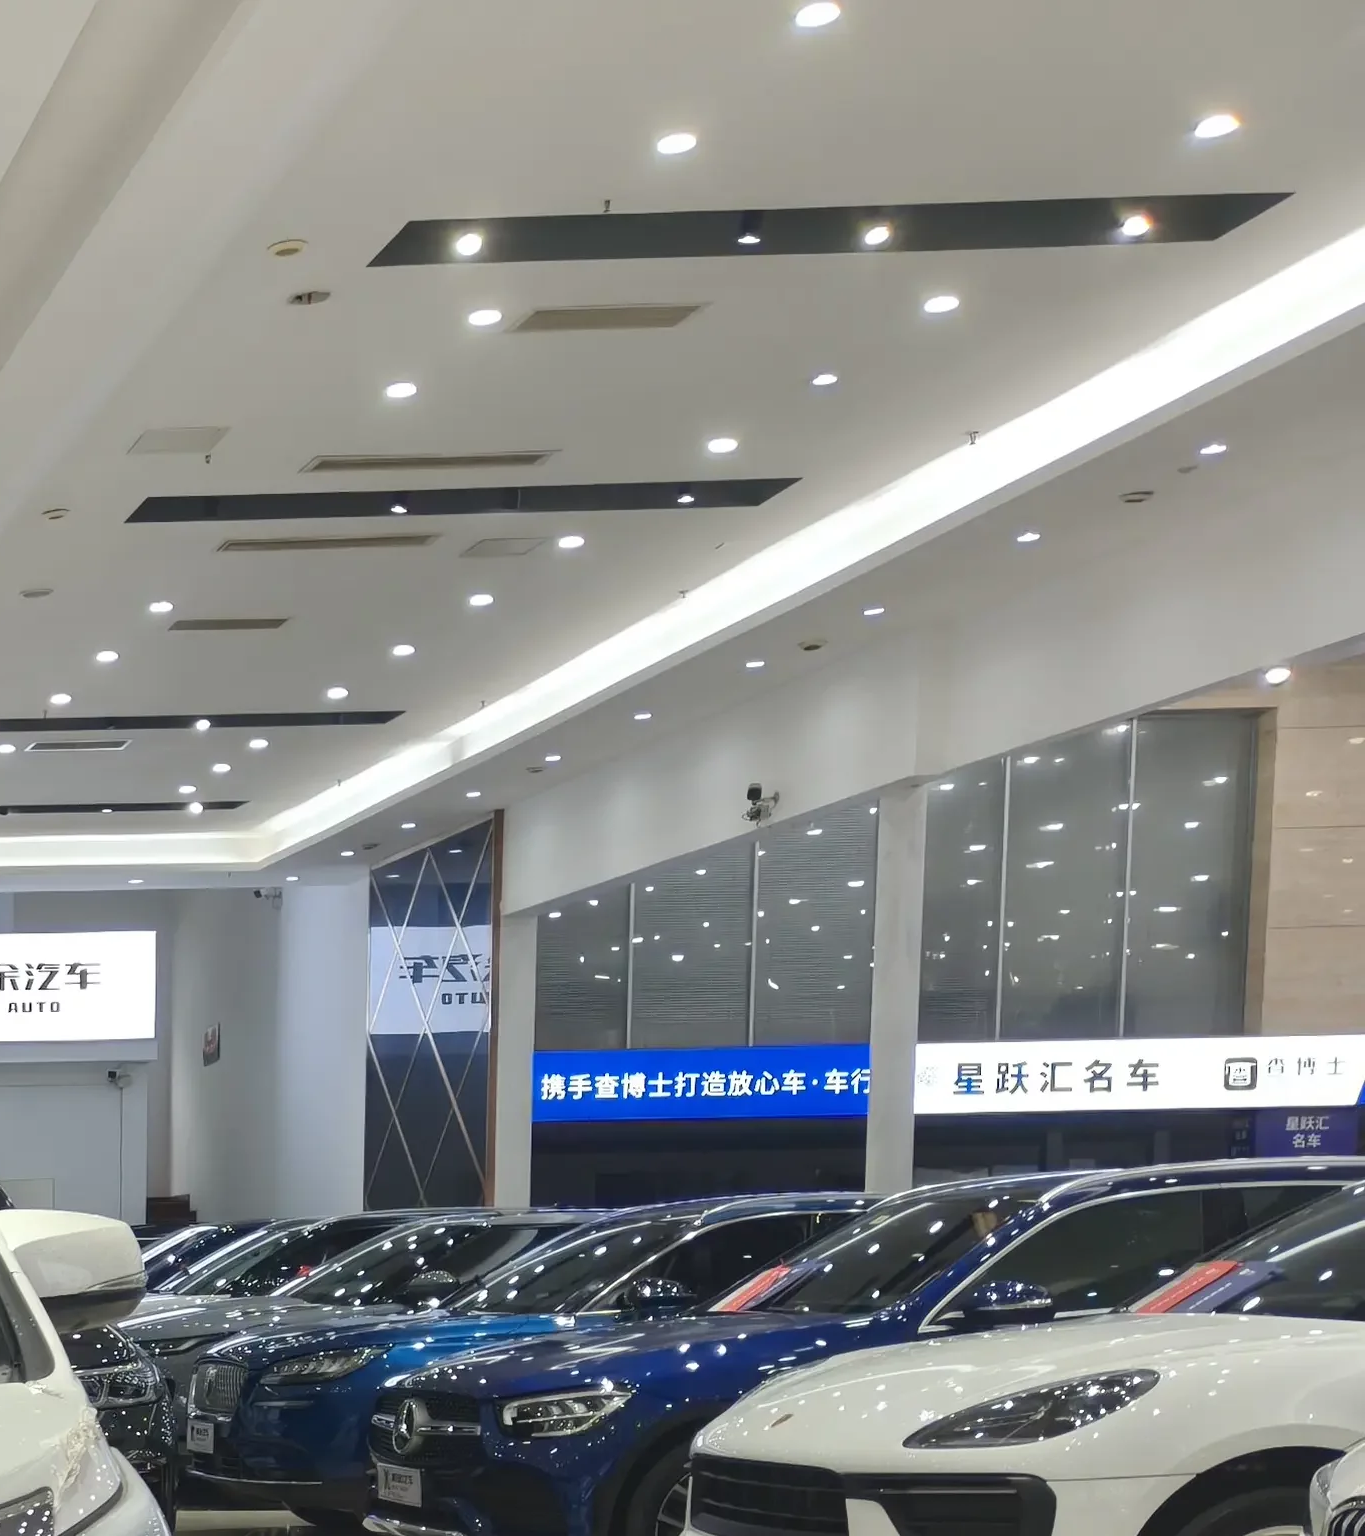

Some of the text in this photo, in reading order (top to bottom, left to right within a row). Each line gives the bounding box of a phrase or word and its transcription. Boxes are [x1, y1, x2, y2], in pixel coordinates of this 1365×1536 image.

[8, 1001, 61, 1013] AUTO
[953, 1058, 1160, 1094] 星跃汇名车
[1285, 1115, 1330, 1131] 星跃汇
[1292, 1133, 1321, 1149] 名车
